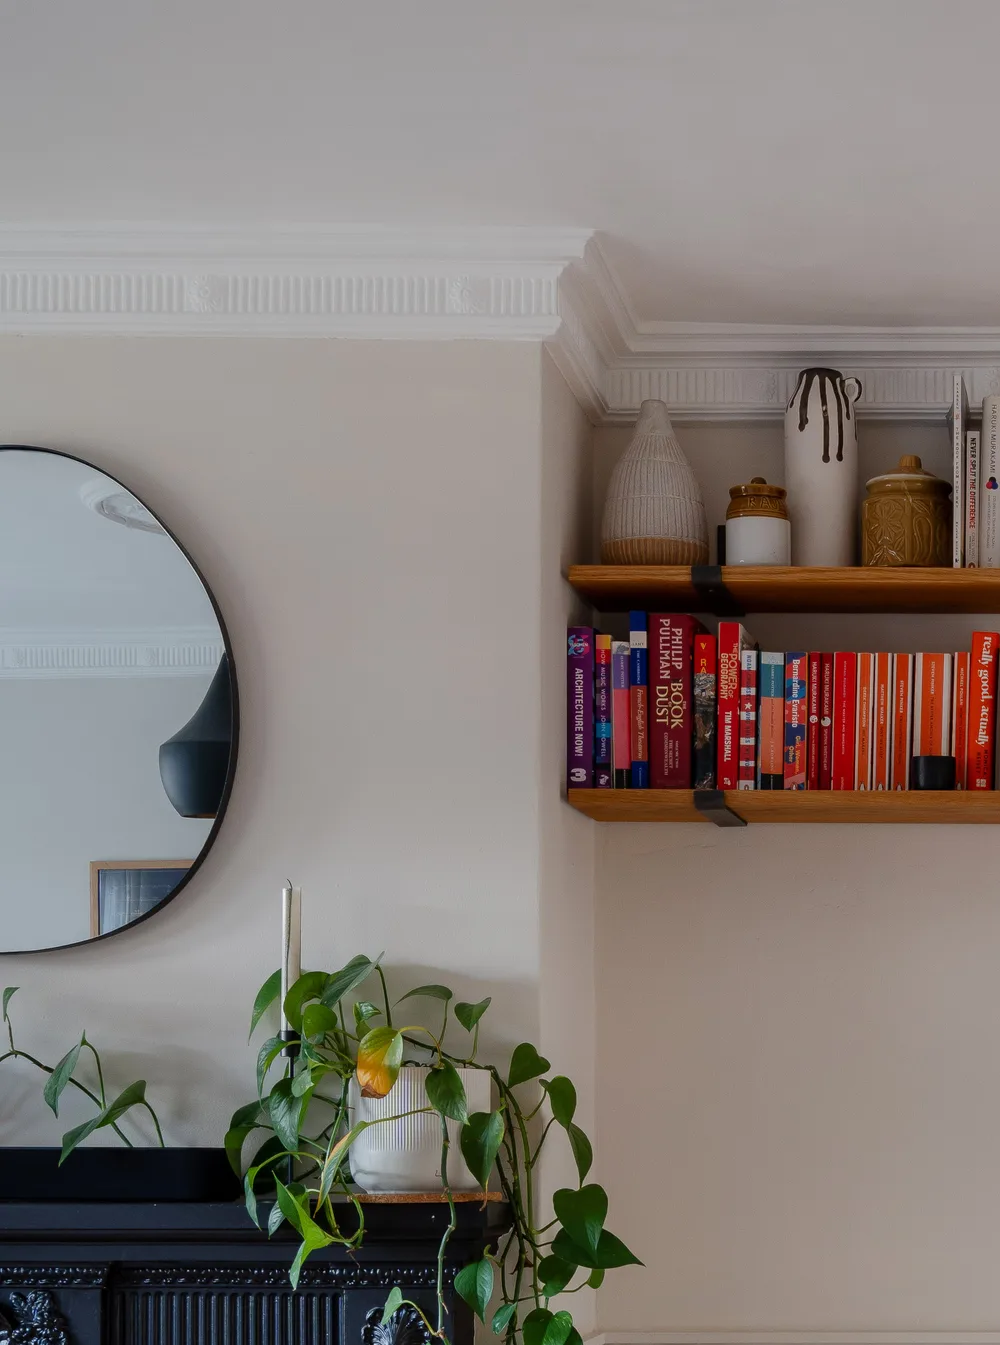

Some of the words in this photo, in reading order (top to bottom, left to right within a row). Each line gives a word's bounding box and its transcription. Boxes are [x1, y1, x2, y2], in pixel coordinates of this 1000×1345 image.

[660, 619, 670, 679] PULLMAN
[671, 628, 682, 670] PHILIP
[978, 636, 993, 667] really
[720, 653, 728, 700] GEOGRAPHY
[728, 653, 737, 689] POWER
[792, 659, 800, 698] Bernardine
[978, 670, 993, 702] good,
[575, 668, 583, 731] ARCHITECTURE
[636, 689, 644, 730] French-English
[656, 686, 669, 725] DUST
[671, 683, 683, 729] BOOK
[791, 699, 799, 728] Evaristo
[575, 734, 583, 756] NOW!
[975, 705, 989, 747] actually
